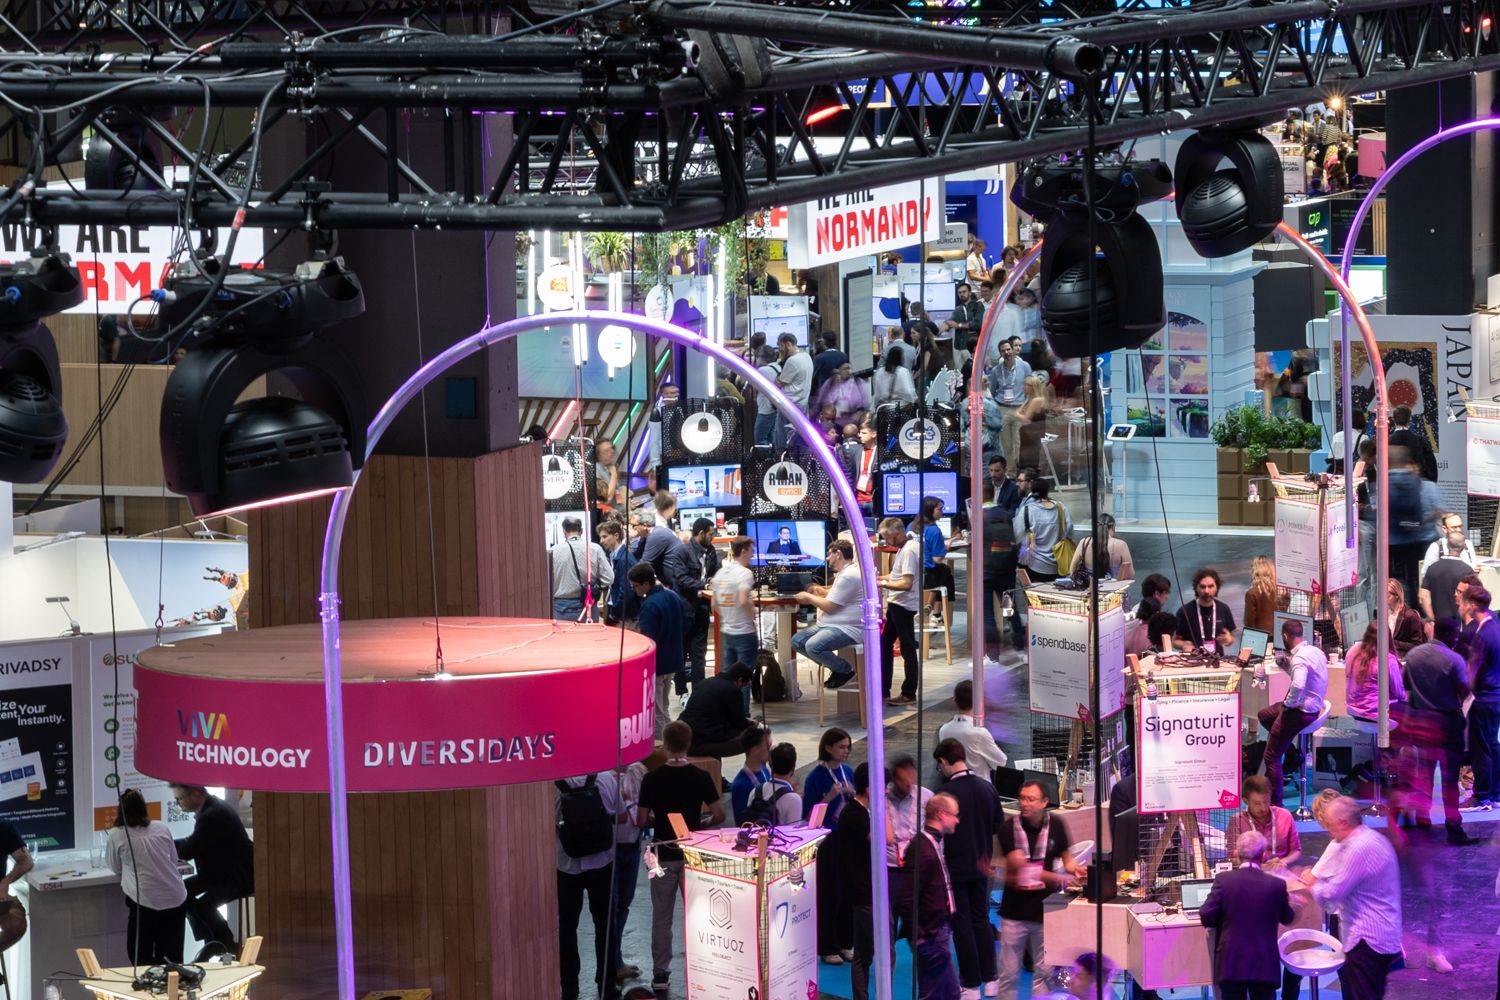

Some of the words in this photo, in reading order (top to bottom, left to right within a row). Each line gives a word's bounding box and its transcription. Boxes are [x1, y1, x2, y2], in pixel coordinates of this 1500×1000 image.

[816, 197, 931, 255] NORMANDY
[768, 473, 802, 487] RMAN
[1037, 636, 1087, 653] spendbase
[18, 714, 65, 726] instantly.
[19, 704, 47, 717] Your
[176, 709, 233, 741] VIVA
[620, 707, 656, 750] BUIL
[1145, 713, 1235, 736] Signaturit
[363, 731, 556, 769] DIVERSIDAYS
[1185, 734, 1226, 748] Group
[176, 741, 312, 769] TECHNOLOGY
[791, 908, 811, 926] PROTECT
[698, 930, 745, 954] VIRTUOZ
